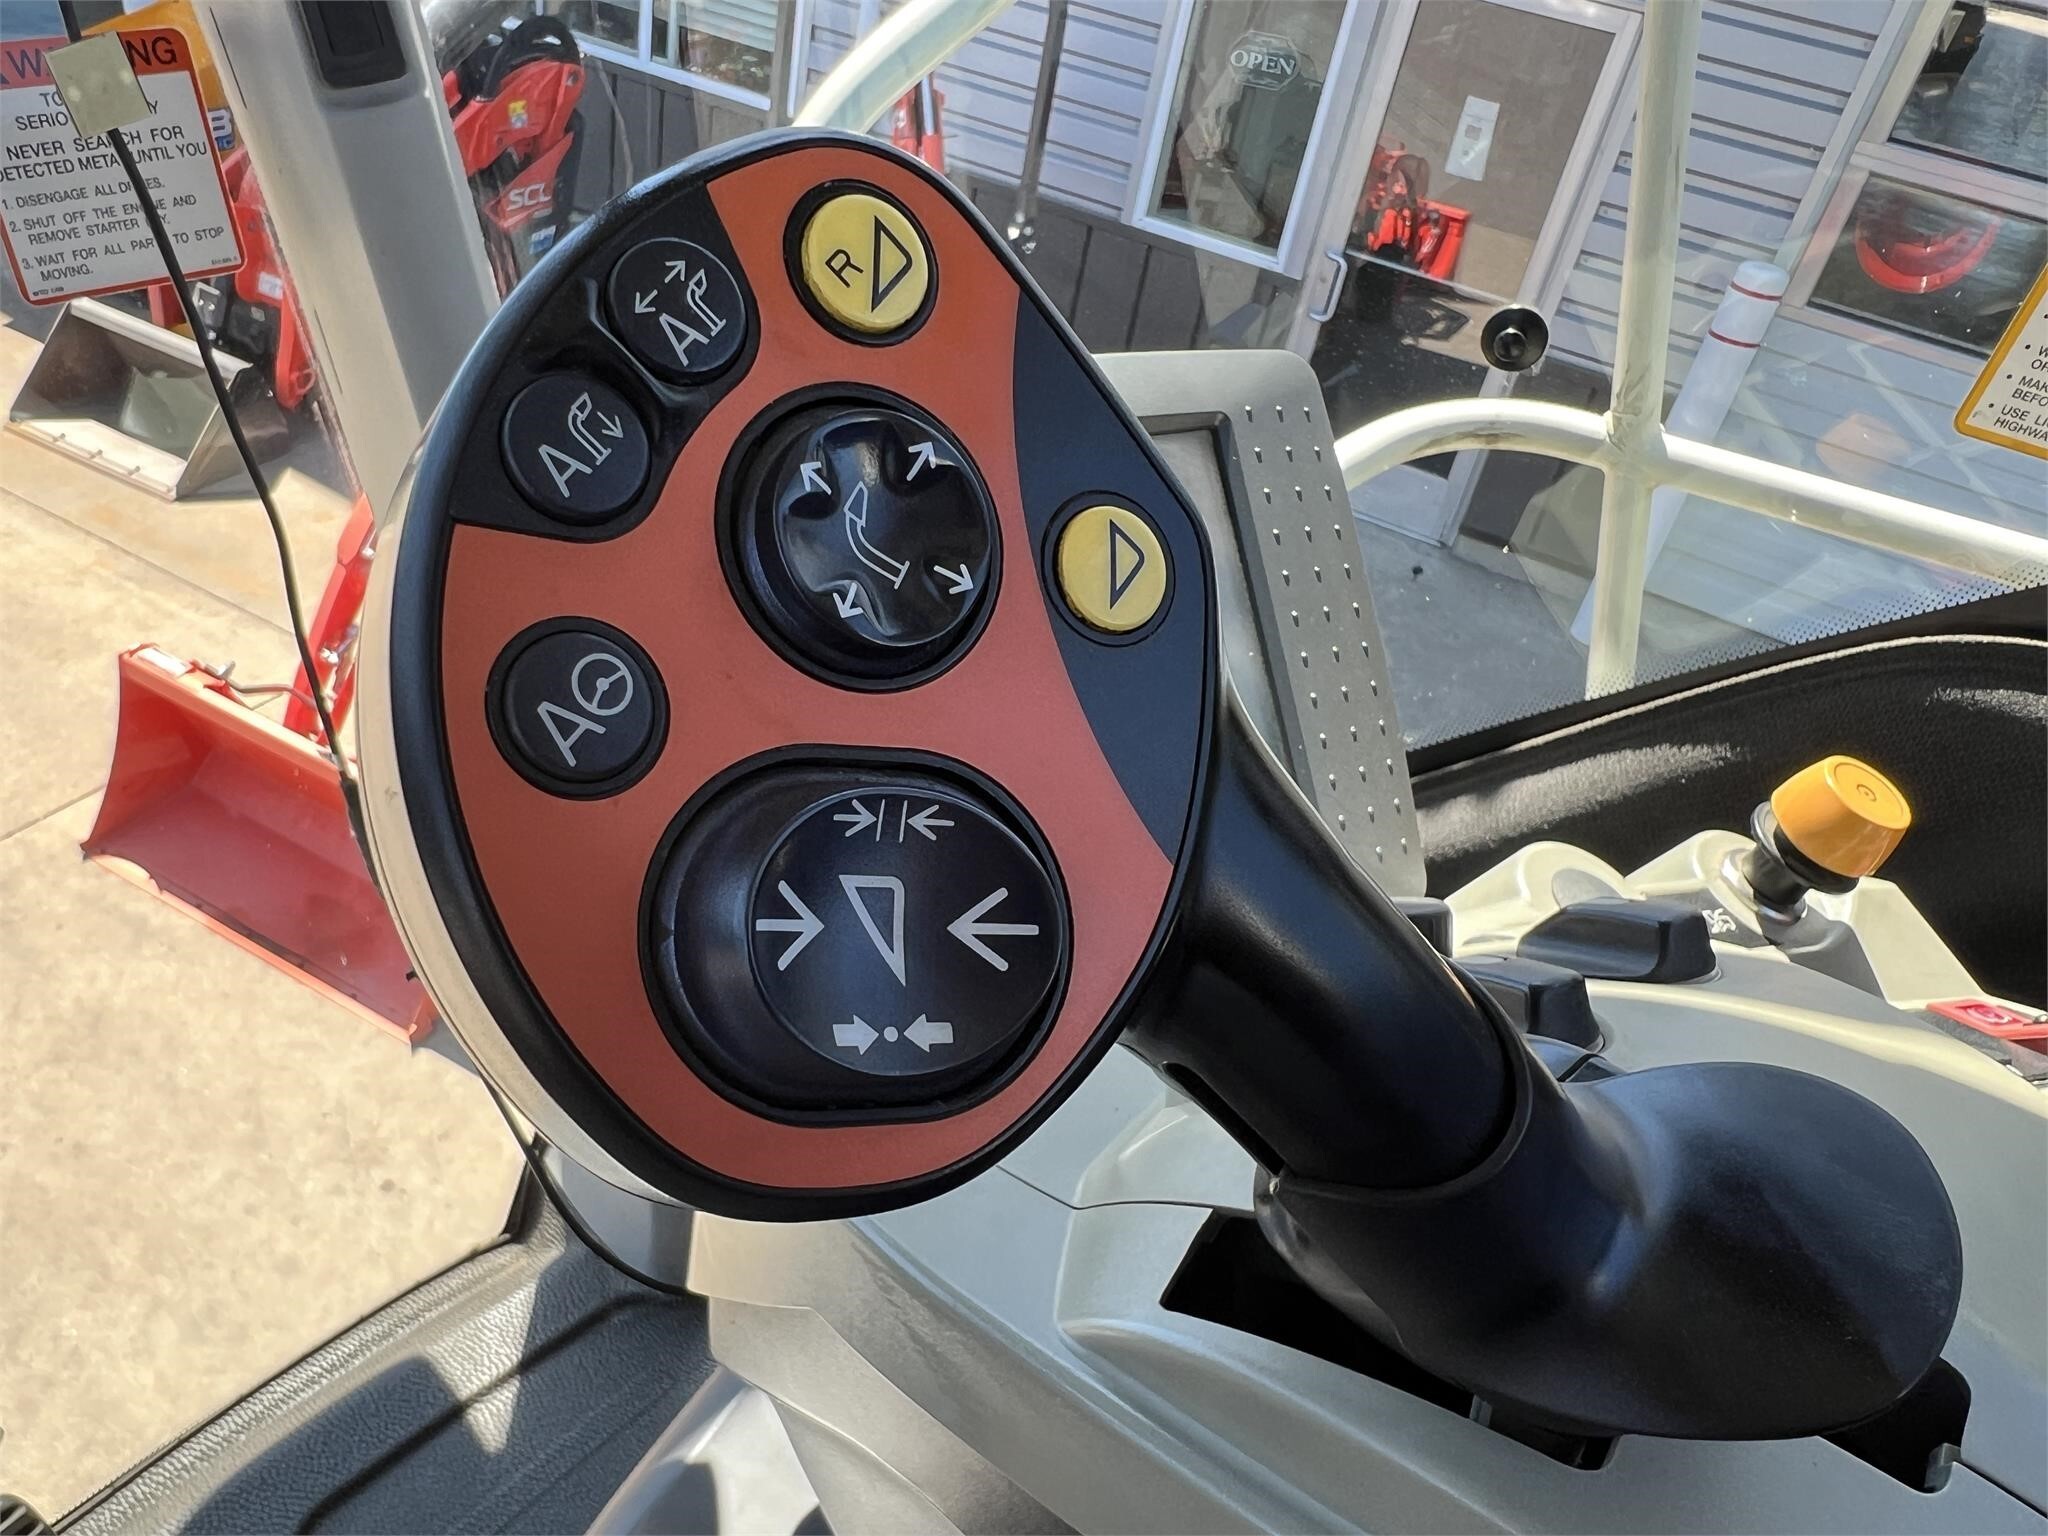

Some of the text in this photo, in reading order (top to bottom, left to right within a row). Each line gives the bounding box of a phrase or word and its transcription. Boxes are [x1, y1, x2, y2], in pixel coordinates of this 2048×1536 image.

[1231, 50, 1295, 75] OPEN
[15, 111, 68, 131] SERIO
[6, 140, 66, 161] NEVER
[150, 125, 185, 142] FOR
[77, 152, 121, 171] META
[131, 146, 174, 164] UNTIL
[175, 141, 207, 158] YOU
[16, 187, 88, 208] DISENGAGE
[94, 183, 117, 197] ALL
[507, 183, 551, 210] SCL
[23, 214, 55, 231] SHUT
[63, 210, 86, 225] OFF
[92, 206, 118, 220] THE
[122, 198, 167, 215] ENNE
[173, 194, 197, 208] AND
[28, 227, 81, 246] REMOVE
[86, 218, 140, 236] STARTER
[34, 252, 65, 267] WAIT
[72, 247, 97, 261] FOR
[104, 243, 125, 255] ALL
[130, 238, 155, 251] PAR
[172, 232, 189, 244] TO
[194, 226, 224, 241] STOP
[40, 264, 94, 282] MOVING.
[824, 247, 865, 288] R
[658, 312, 709, 366] A
[2001, 404, 2030, 421] USE
[539, 443, 592, 498] A
[537, 701, 606, 767] A
